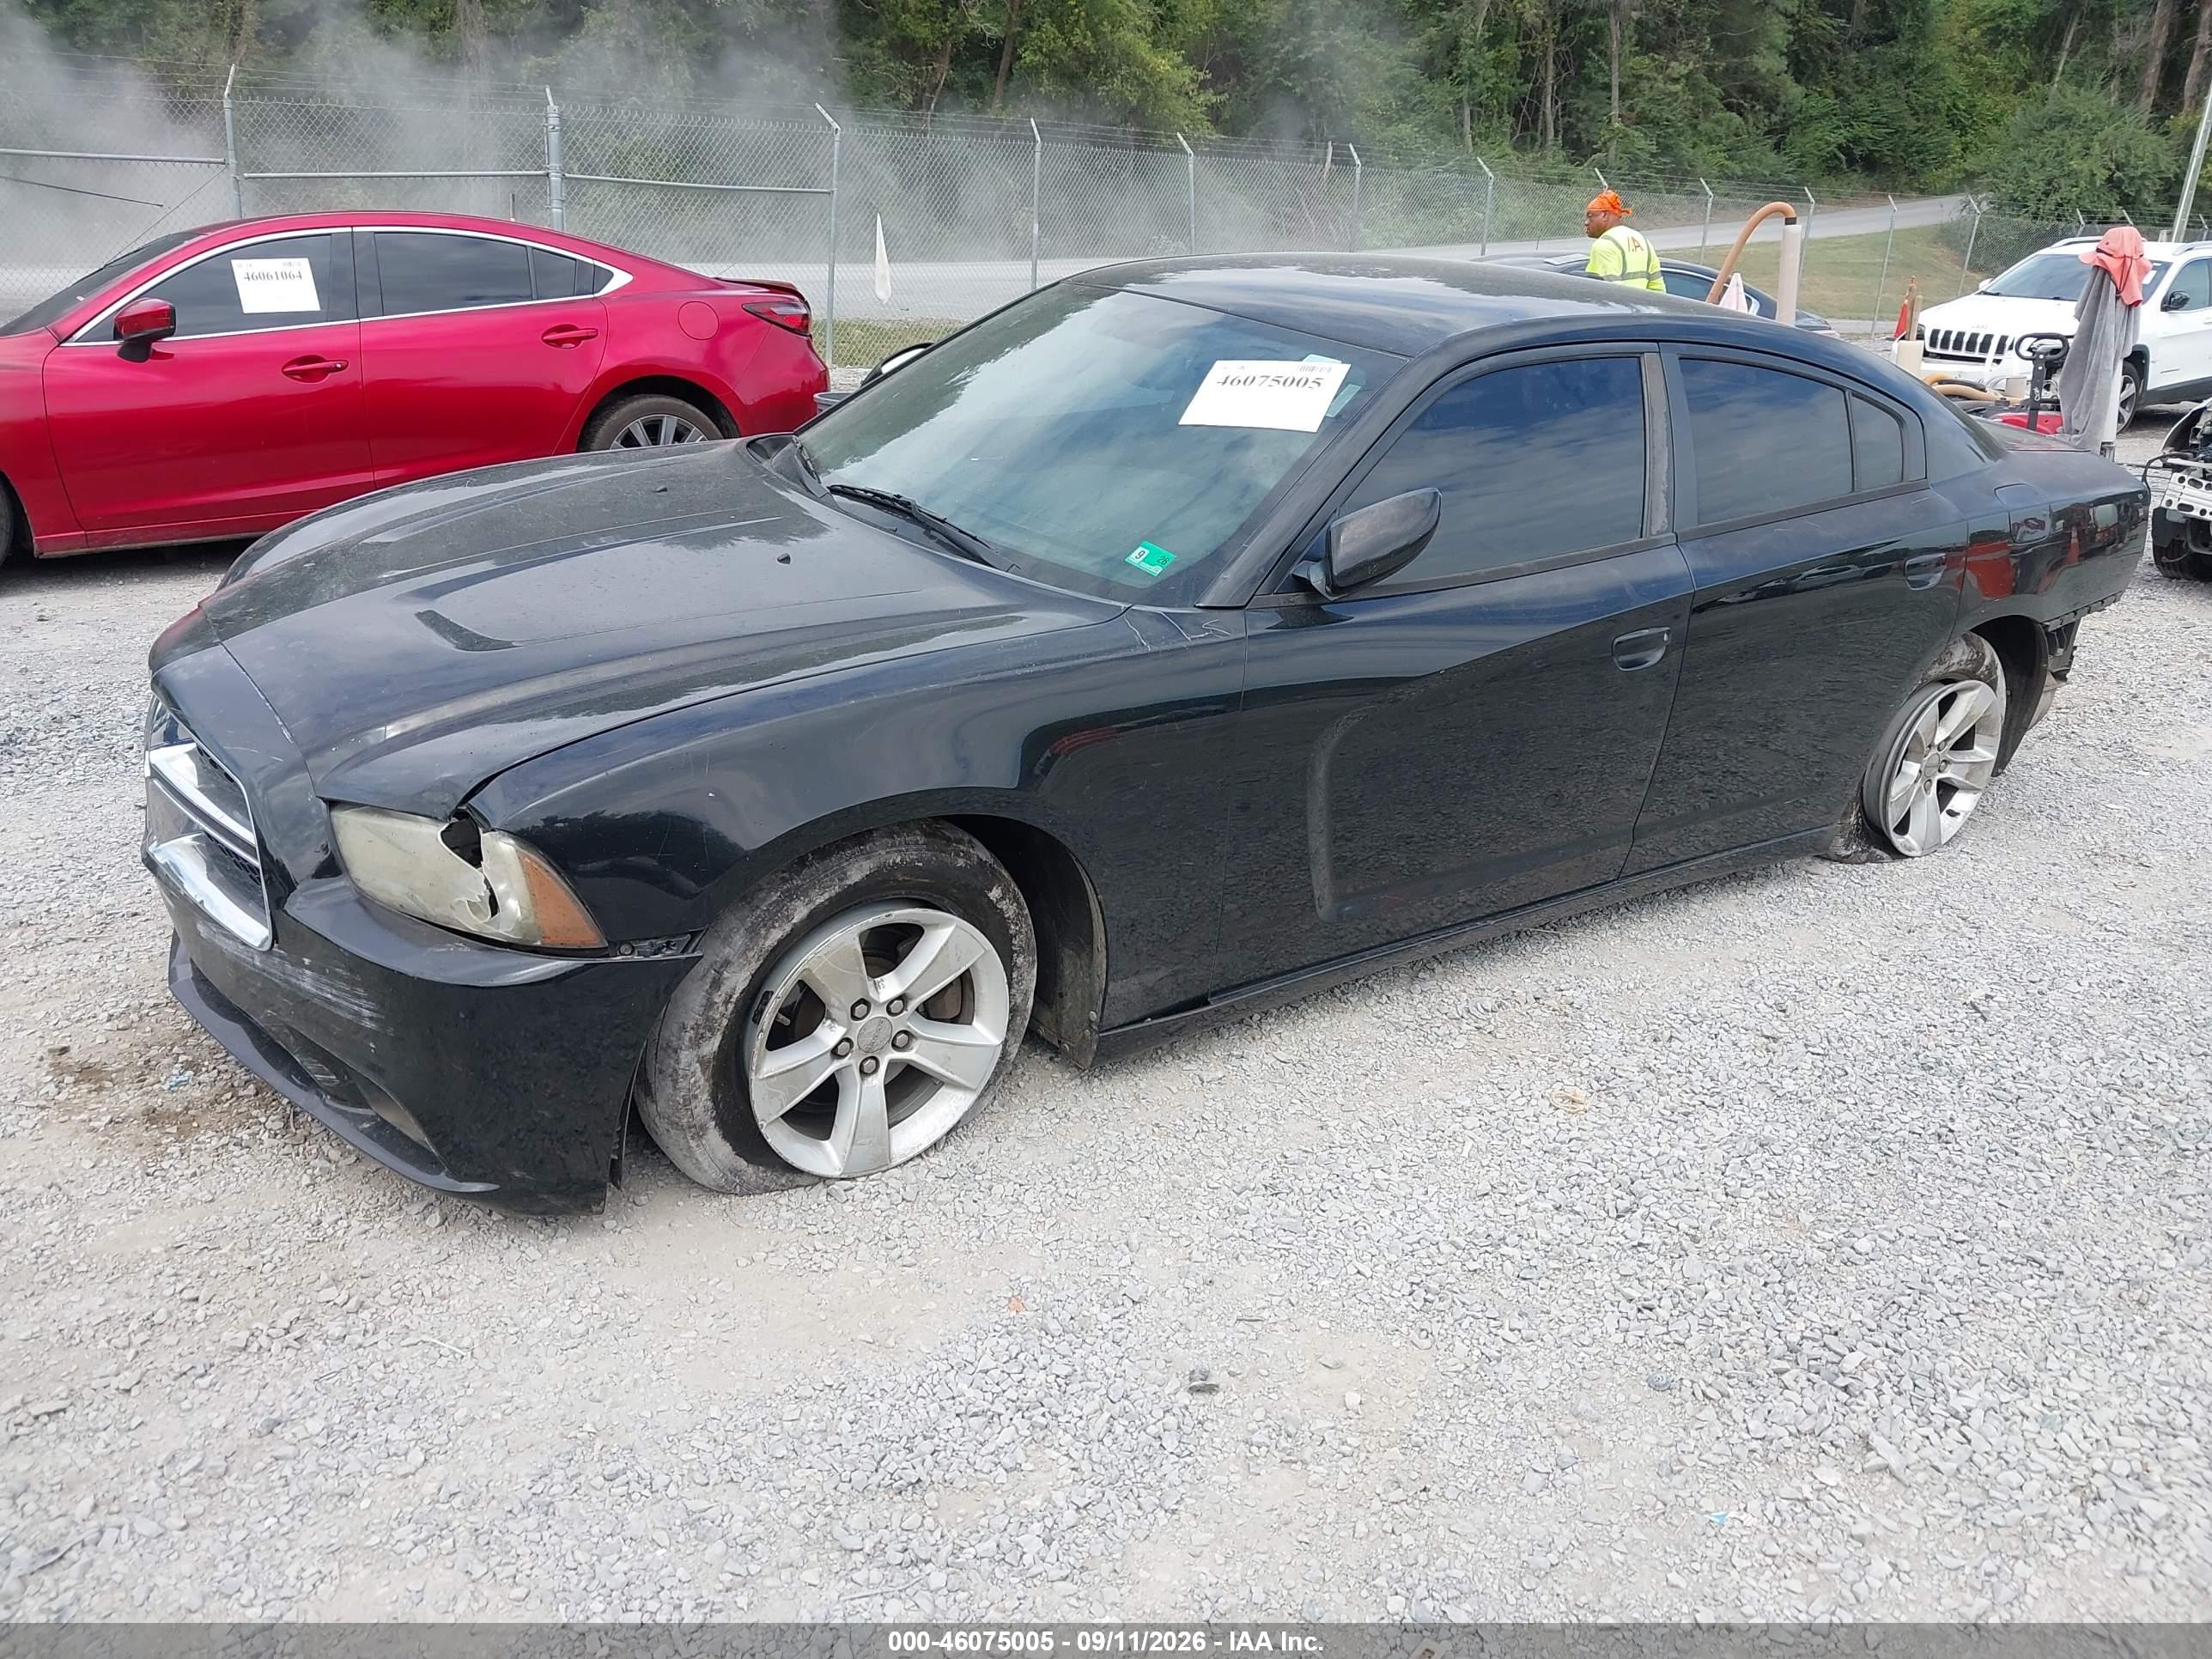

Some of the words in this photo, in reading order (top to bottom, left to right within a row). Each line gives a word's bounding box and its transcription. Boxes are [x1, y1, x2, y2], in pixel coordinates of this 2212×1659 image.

[244, 270, 302, 282] 46061064
[1217, 375, 1324, 388] 46075005
[1135, 550, 1146, 559] 9
